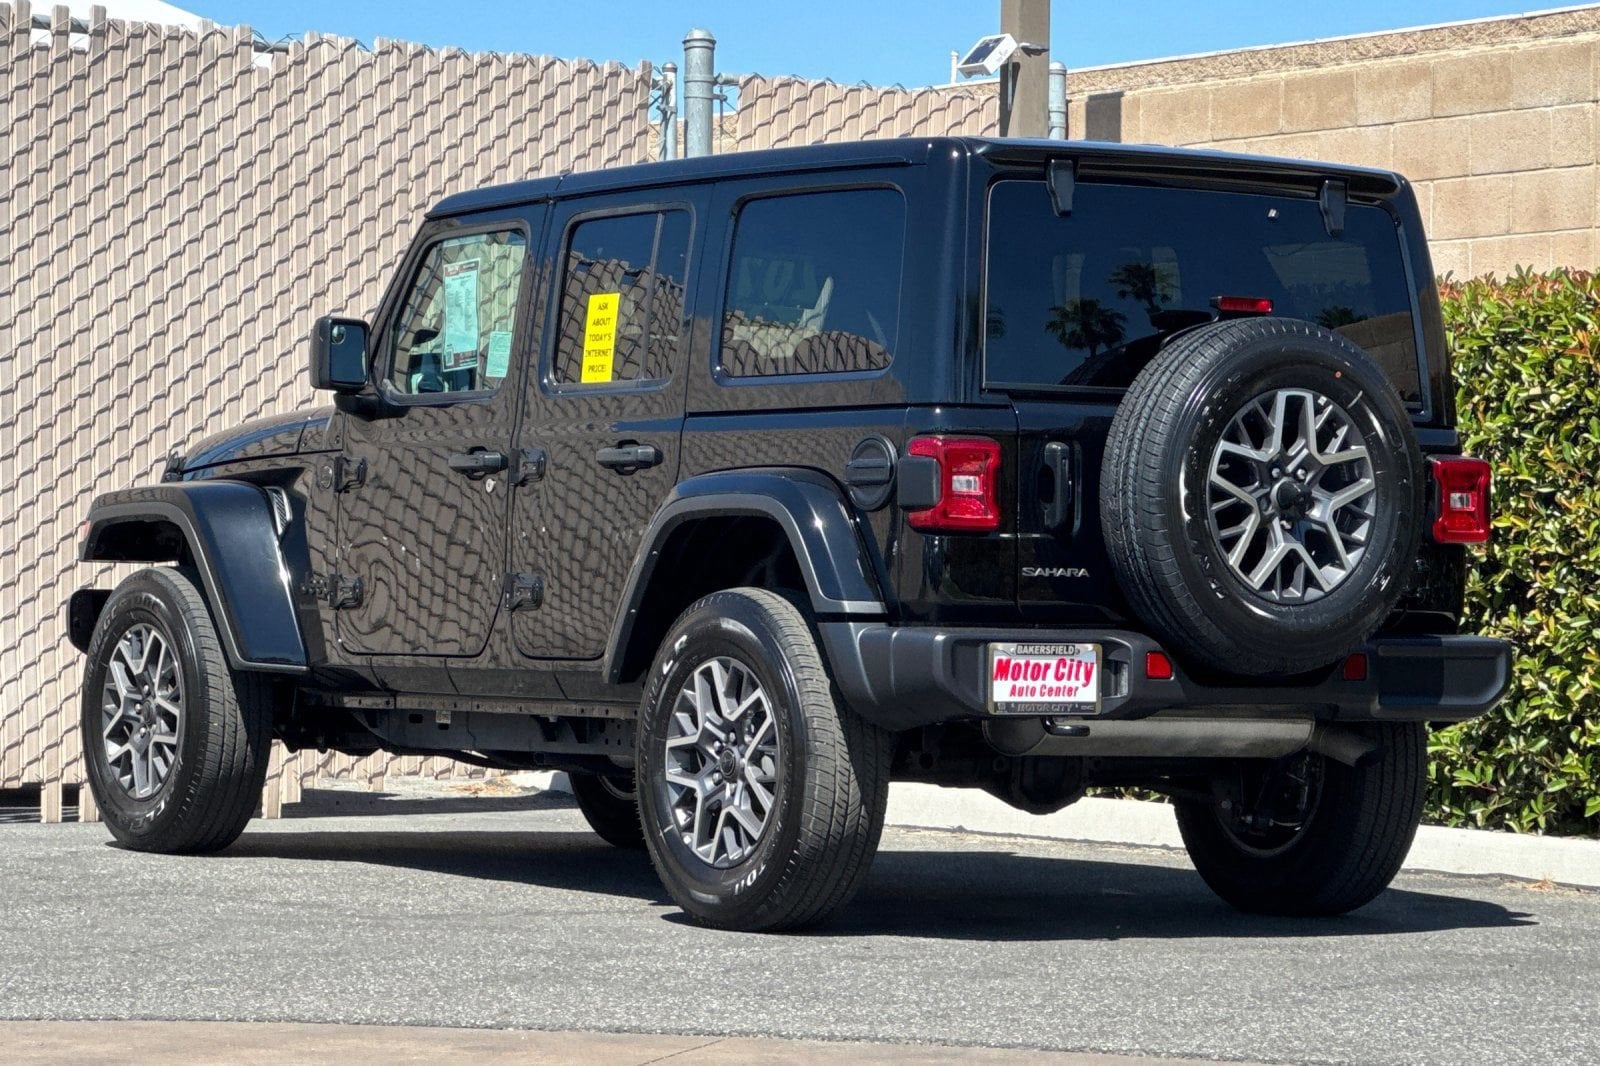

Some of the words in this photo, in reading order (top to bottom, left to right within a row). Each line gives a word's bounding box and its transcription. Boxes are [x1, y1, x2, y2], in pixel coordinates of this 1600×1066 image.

[597, 302, 609, 311] ASK
[592, 317, 611, 327] ABOUT
[589, 333, 612, 342] TODAY'S
[584, 348, 612, 358] INTERNET
[1022, 567, 1090, 578] SAHARA
[1017, 645, 1075, 655] BAKERSFIELD
[993, 658, 1052, 681] Motor
[1054, 658, 1095, 688] City
[1009, 684, 1037, 697] Auto
[1039, 684, 1079, 697] Center
[1017, 703, 1050, 712] MOTOR
[1051, 703, 1072, 712] CITY
